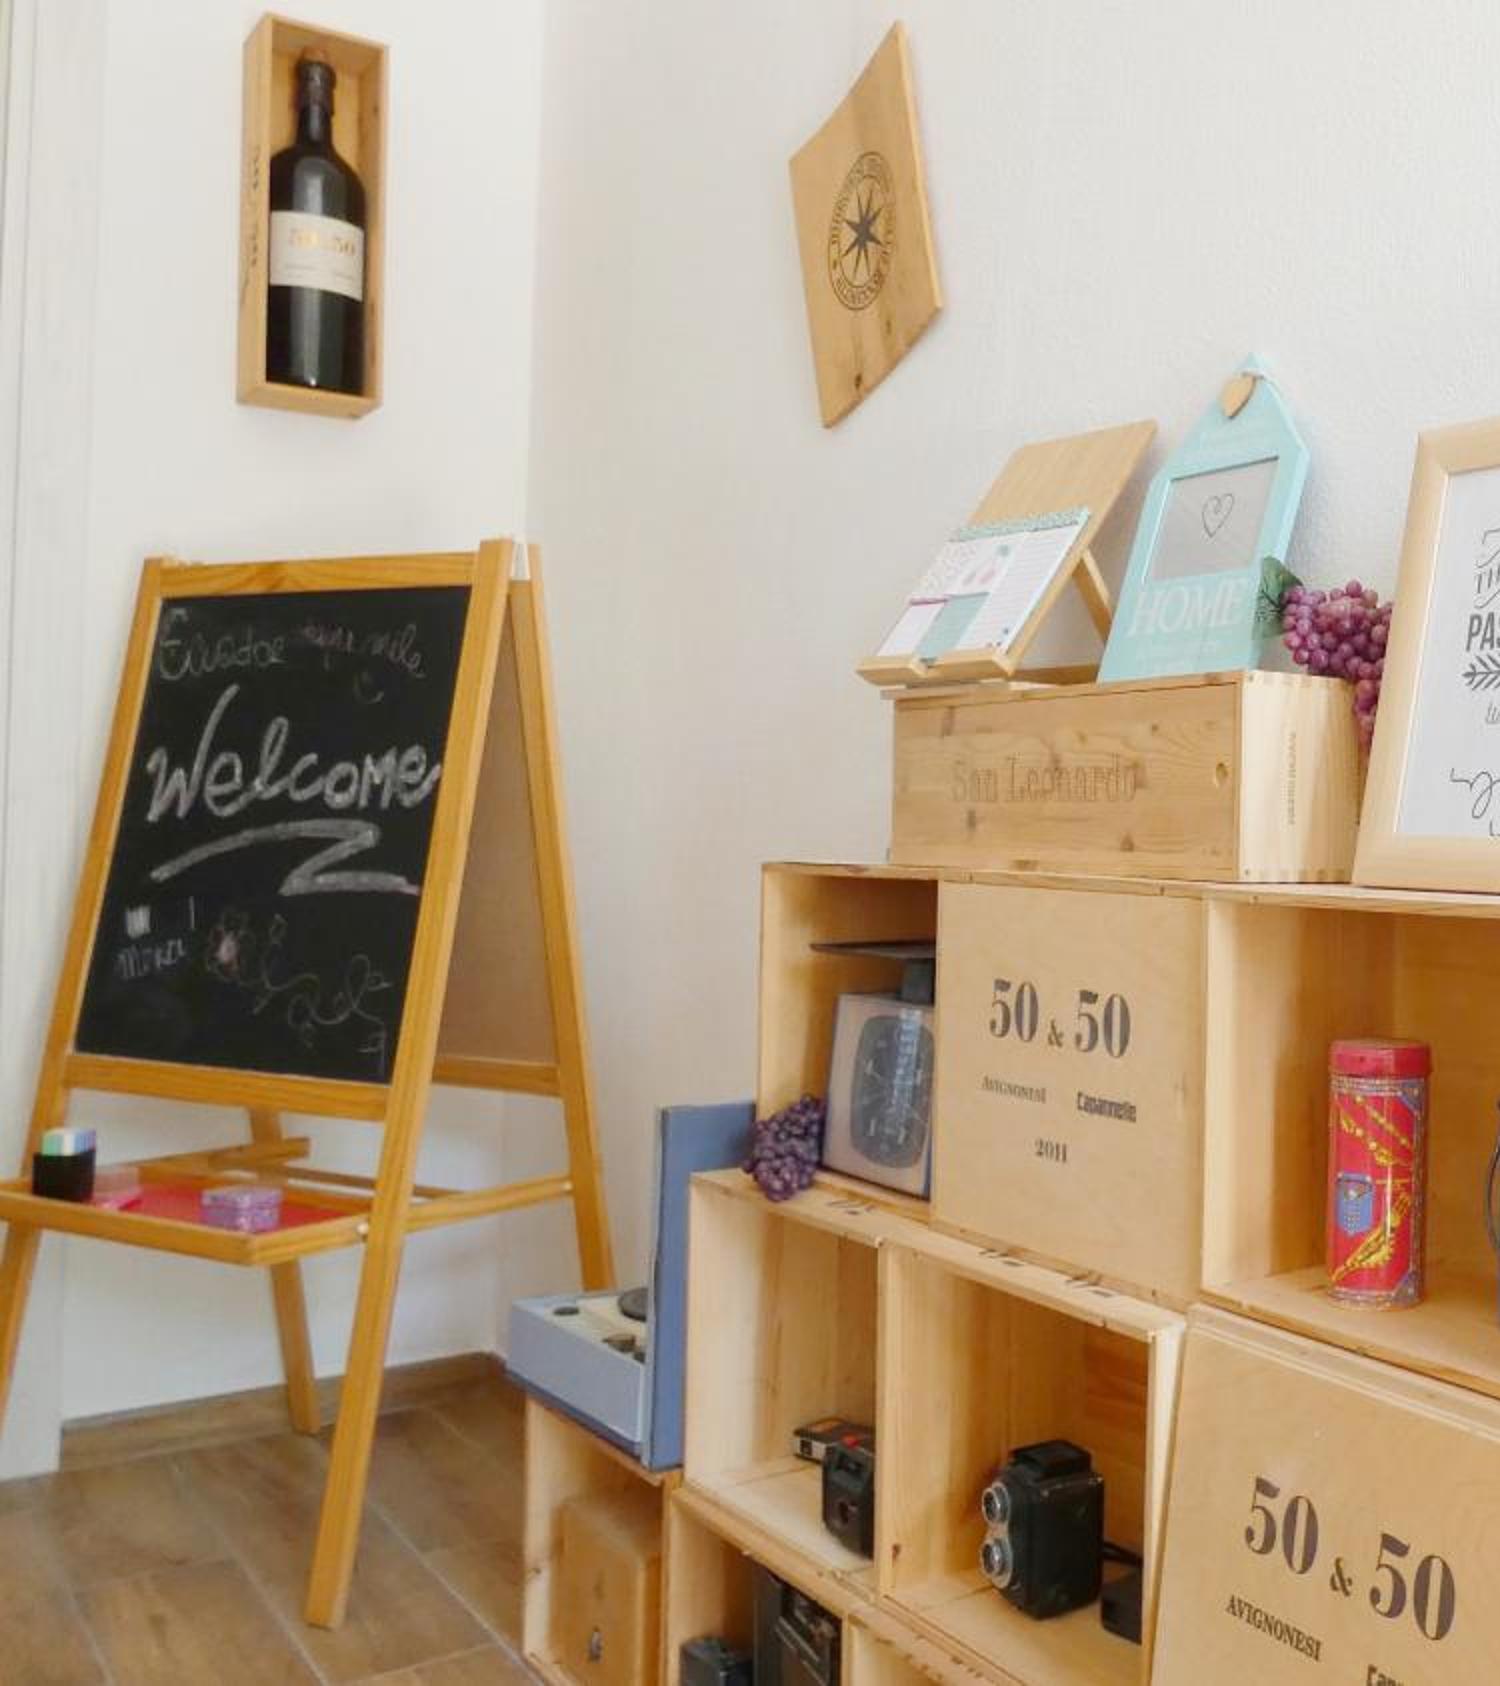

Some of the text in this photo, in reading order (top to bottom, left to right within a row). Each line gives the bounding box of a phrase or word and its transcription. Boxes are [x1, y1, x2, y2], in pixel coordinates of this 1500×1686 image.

[1128, 584, 1241, 637] HOME
[1006, 751, 1137, 803] Leonardo
[989, 978, 1131, 1059] 50 & 50
[1244, 1476, 1456, 1641] 50 & 50
[1226, 1595, 1323, 1662] AVIGNONESI
